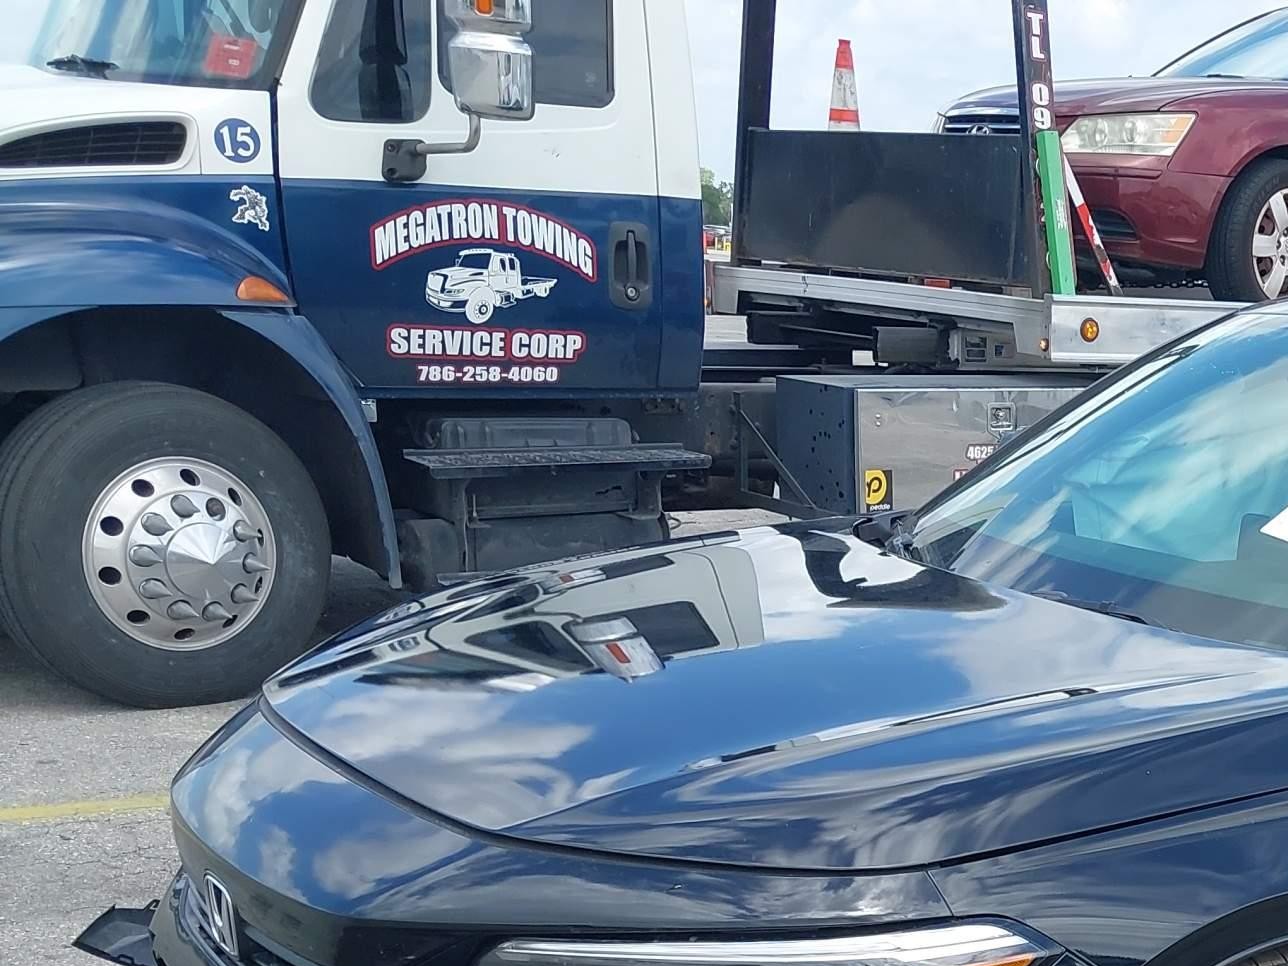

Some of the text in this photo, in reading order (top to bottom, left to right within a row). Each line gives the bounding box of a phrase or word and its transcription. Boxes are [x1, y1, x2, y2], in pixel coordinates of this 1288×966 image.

[220, 126, 255, 157] 15
[374, 202, 594, 278] MEGATRON TOWING
[390, 327, 583, 359] SERVICE CORP
[417, 365, 559, 382] 786-258-4060
